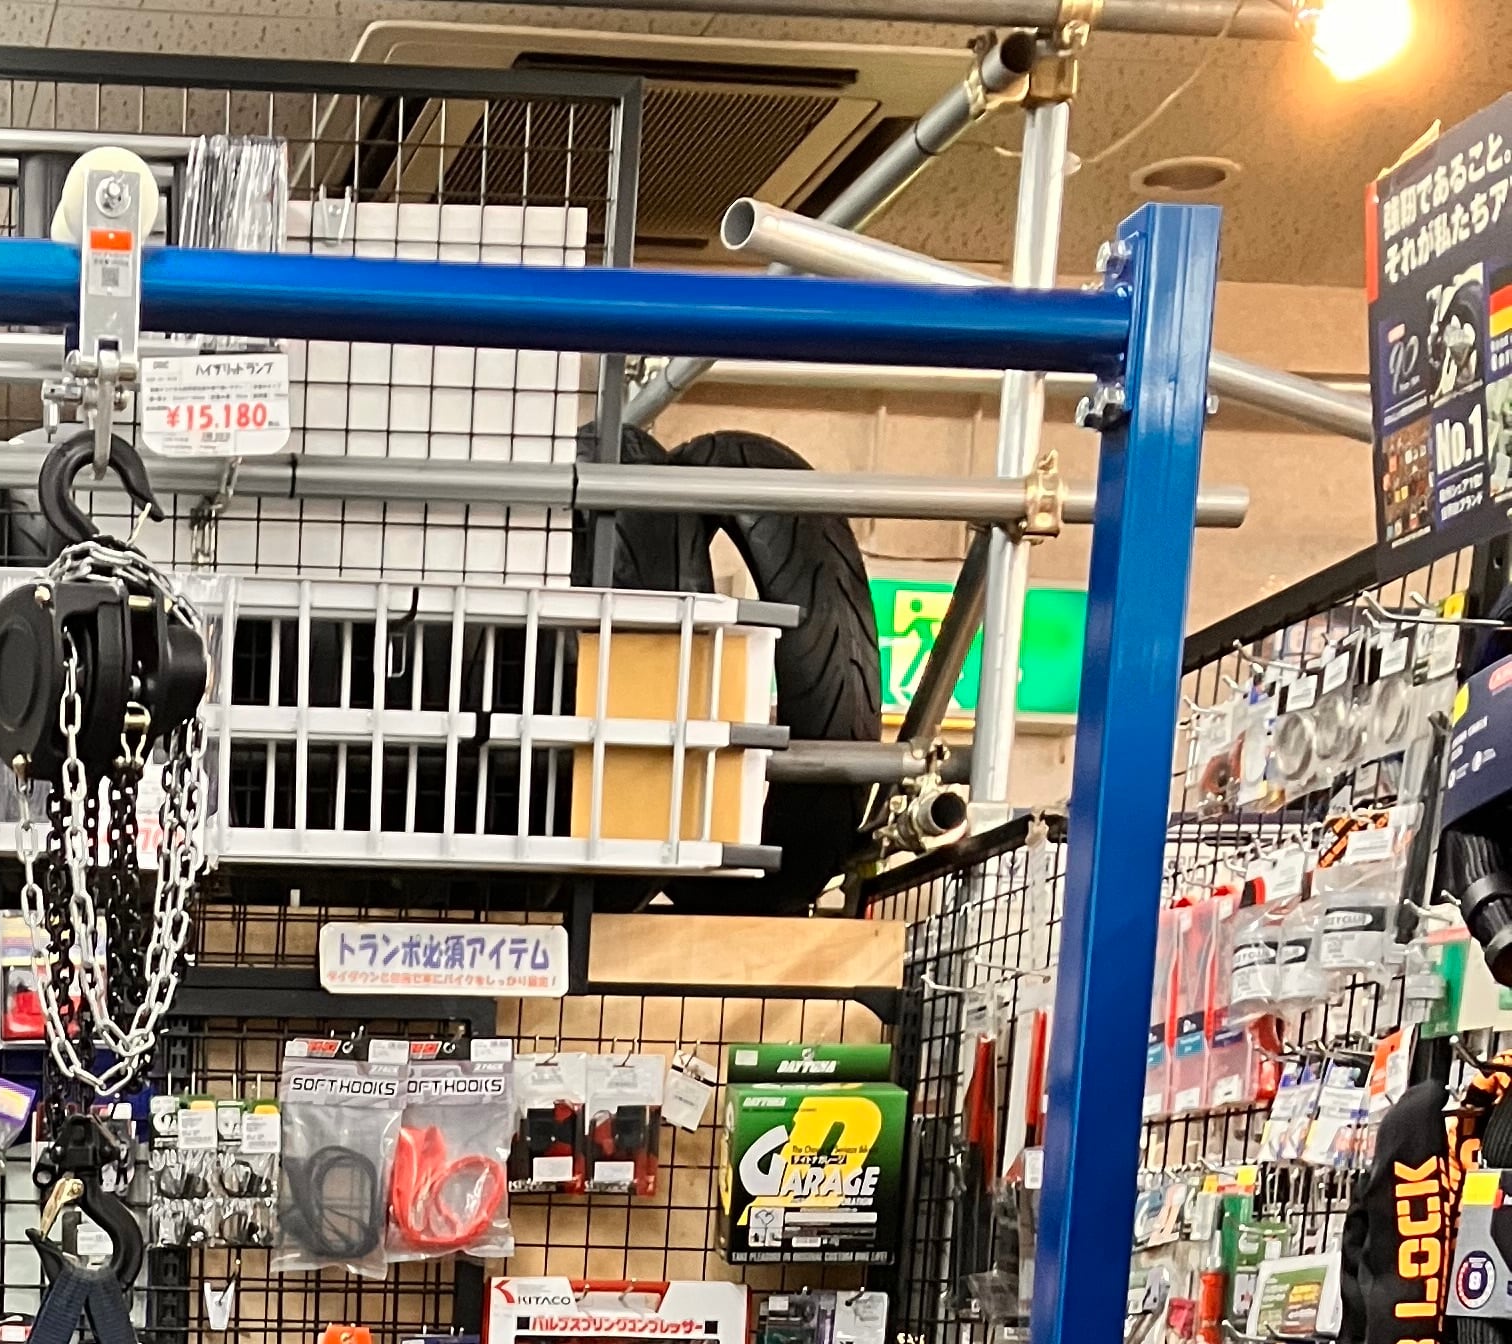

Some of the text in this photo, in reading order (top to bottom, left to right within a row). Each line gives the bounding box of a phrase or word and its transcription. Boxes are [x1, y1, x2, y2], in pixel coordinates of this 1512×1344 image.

[1385, 176, 1512, 283] それが私たちア
[1435, 403, 1483, 475] No.1
[340, 932, 549, 970] トランポ必須アイテム
[739, 1124, 881, 1197] GARAGE
[1395, 1155, 1443, 1320] LOCK
[517, 1295, 571, 1306] KITACO
[531, 1316, 703, 1335] バルブスプリングコンプレッサー
